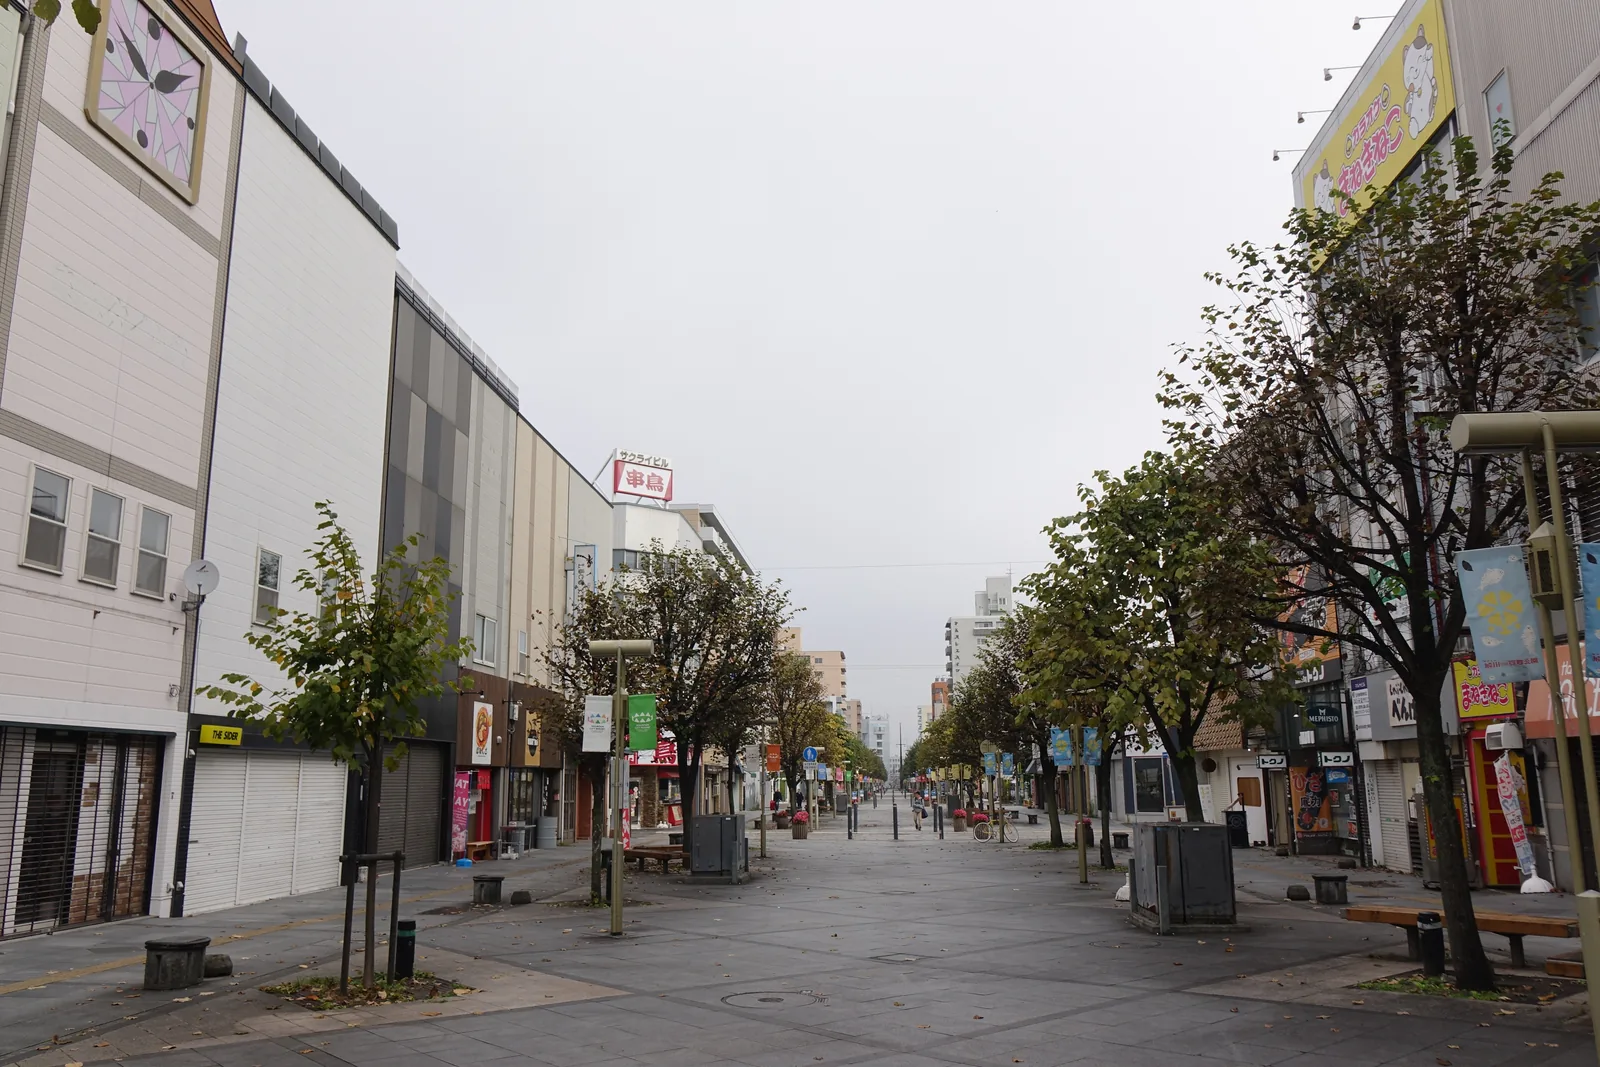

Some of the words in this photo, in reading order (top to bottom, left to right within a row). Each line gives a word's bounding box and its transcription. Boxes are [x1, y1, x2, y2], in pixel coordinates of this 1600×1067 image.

[620, 450, 669, 468] サクライビル
[626, 468, 664, 493] 串鳥
[1461, 680, 1509, 712] まねきねこ
[212, 730, 222, 739] THE
[224, 731, 238, 740] SIDER
